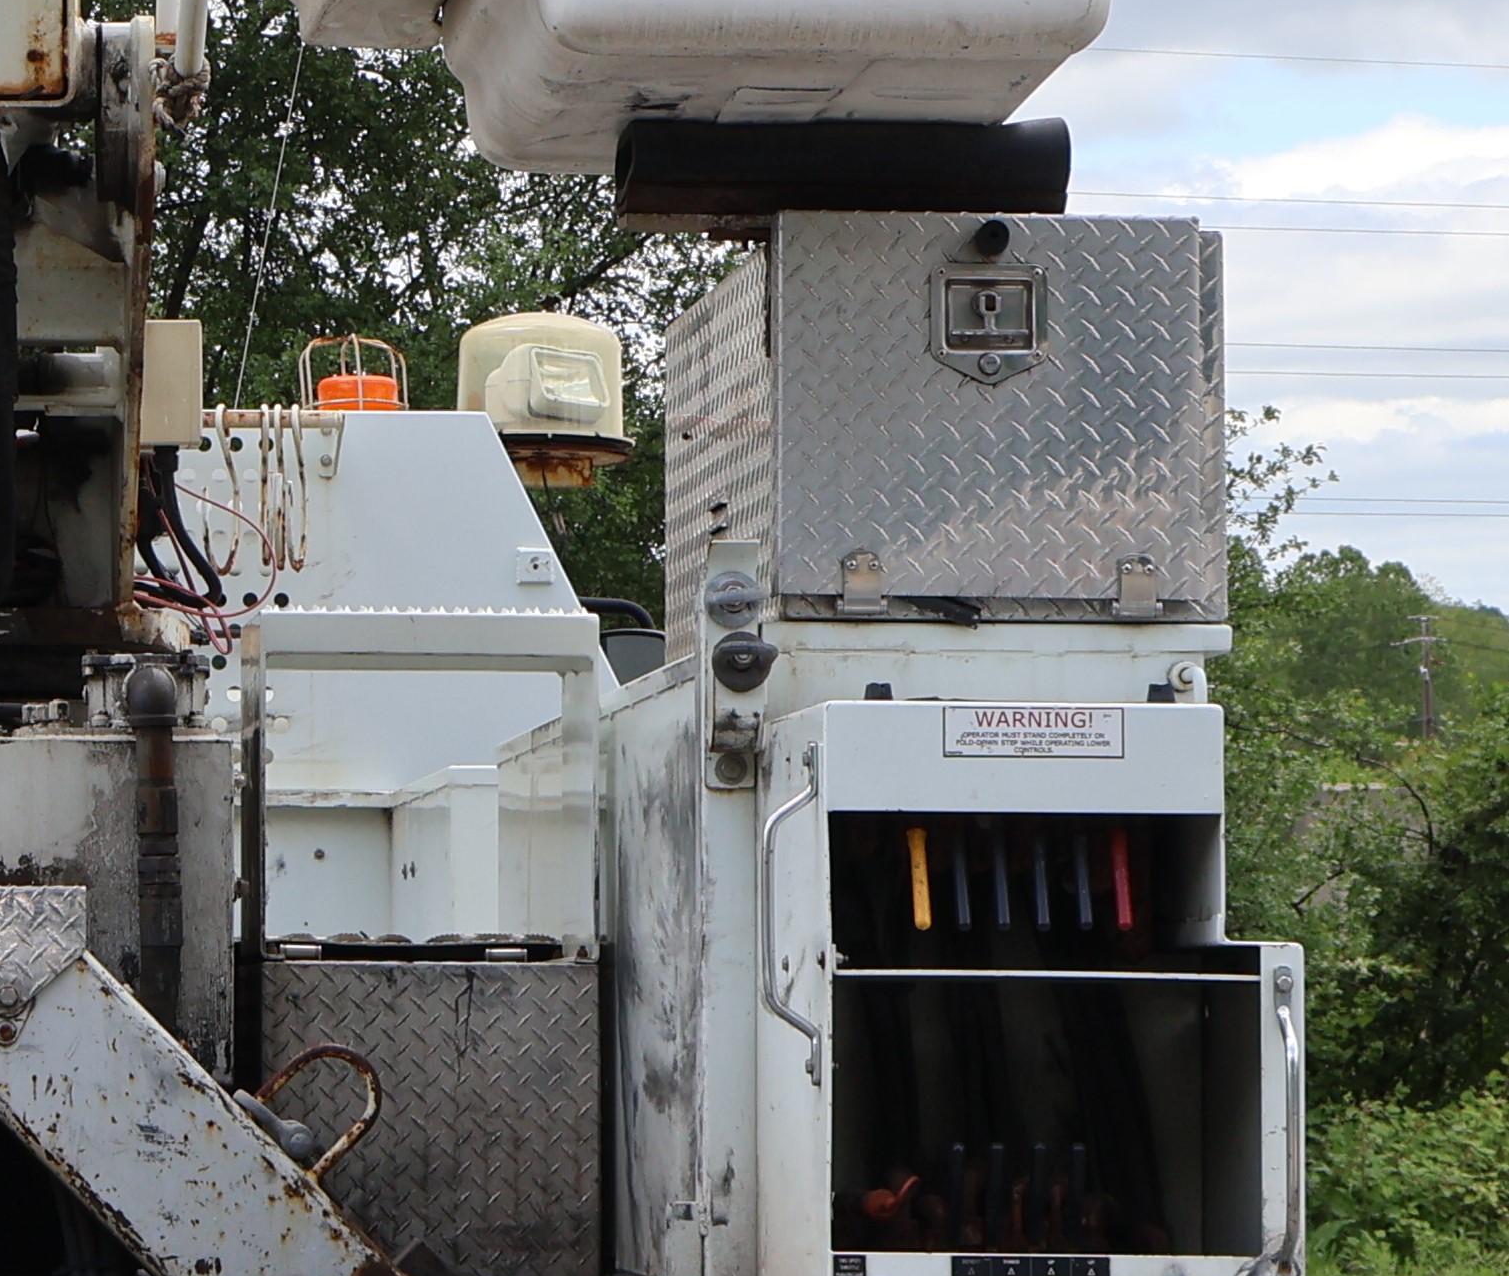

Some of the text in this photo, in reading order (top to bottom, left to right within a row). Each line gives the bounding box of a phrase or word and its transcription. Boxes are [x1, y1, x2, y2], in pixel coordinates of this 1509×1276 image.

[975, 710, 1093, 729] WARNING!
[962, 731, 1105, 740] OPERATOR MUST STAND COMPLETELY ON
[956, 739, 1111, 747] FOLD-DOWN STEP WHILE OPERATING LOWER
